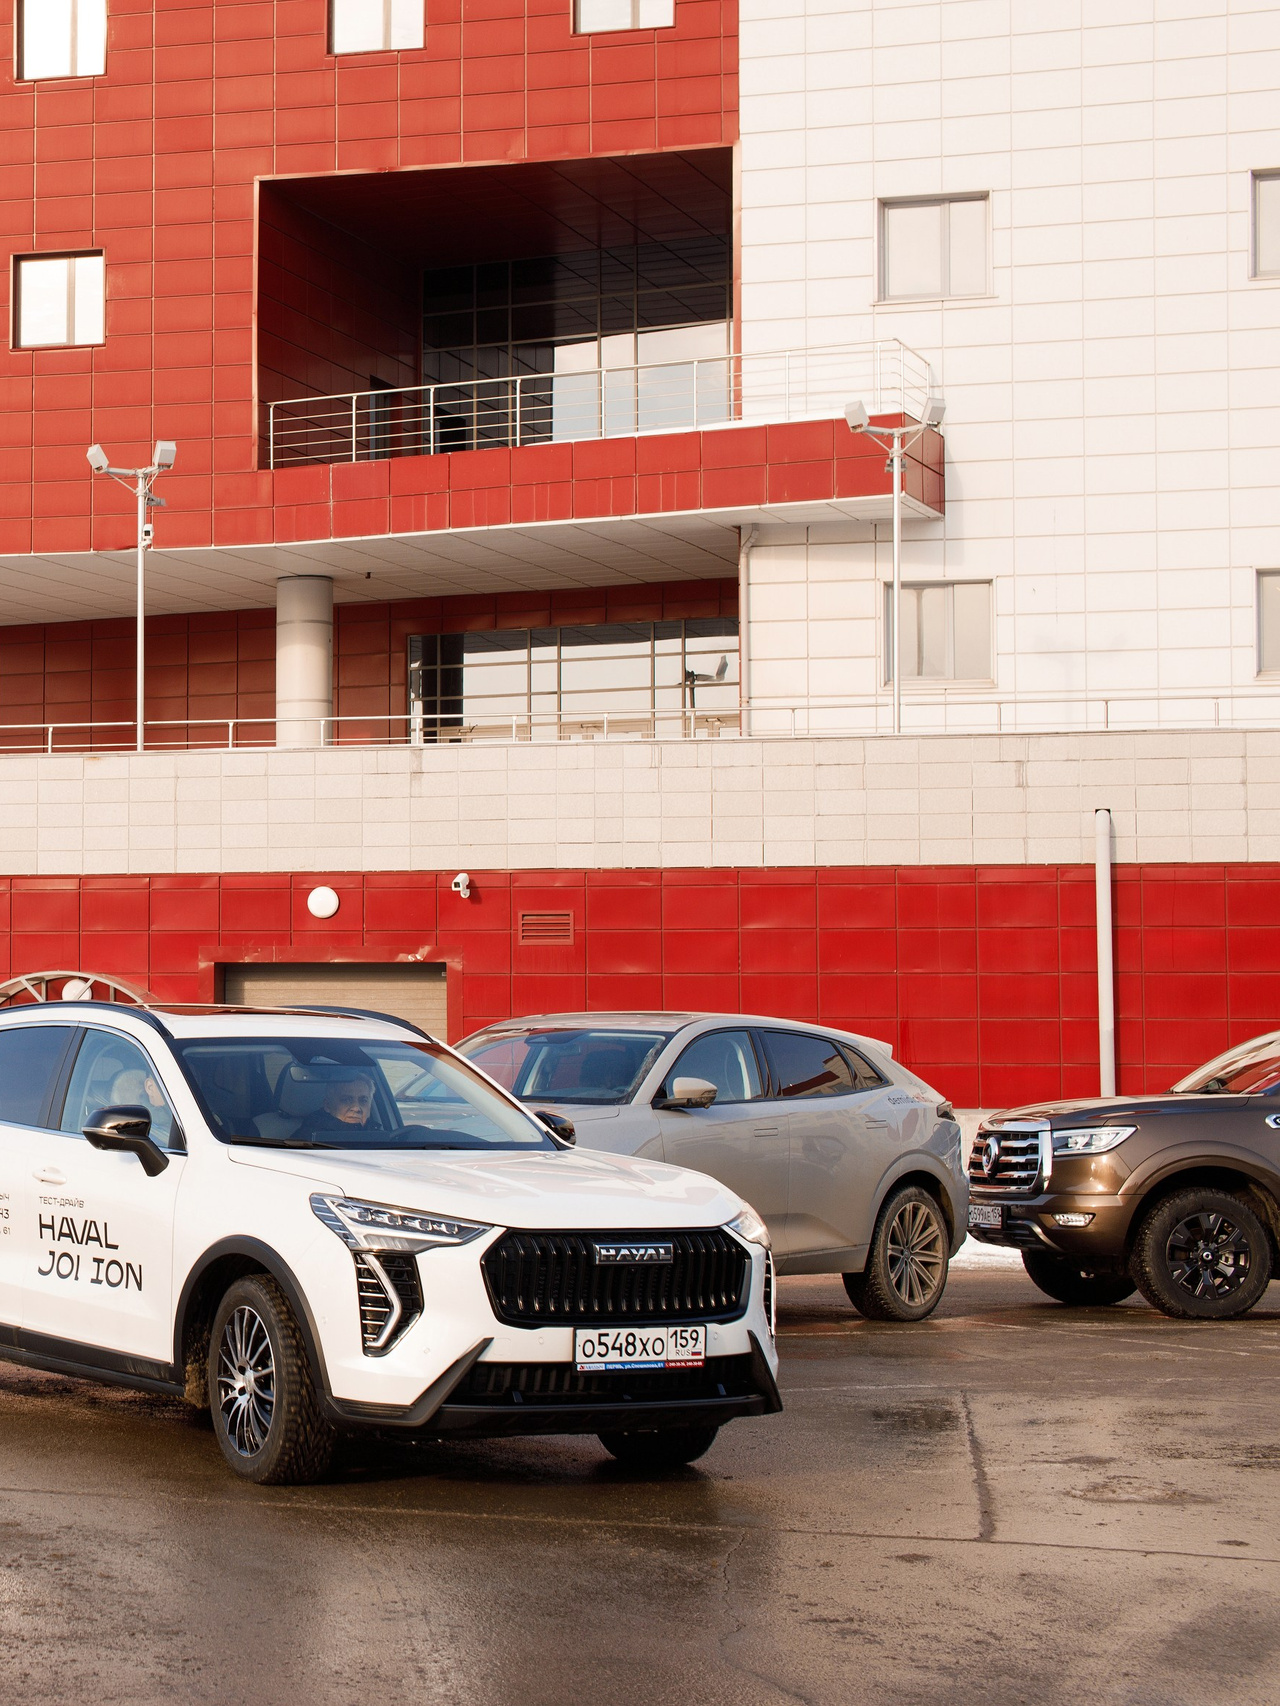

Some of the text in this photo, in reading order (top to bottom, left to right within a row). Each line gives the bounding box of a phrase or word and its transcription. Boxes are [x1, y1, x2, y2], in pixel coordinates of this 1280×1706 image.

[39, 1196, 85, 1209] ТЕСТ-ДРАЙВ
[2, 1226, 11, 1235] 61
[38, 1213, 119, 1250] HAVAL
[600, 1247, 671, 1261] HAVAL
[582, 1329, 700, 1358] О548ХО 159
